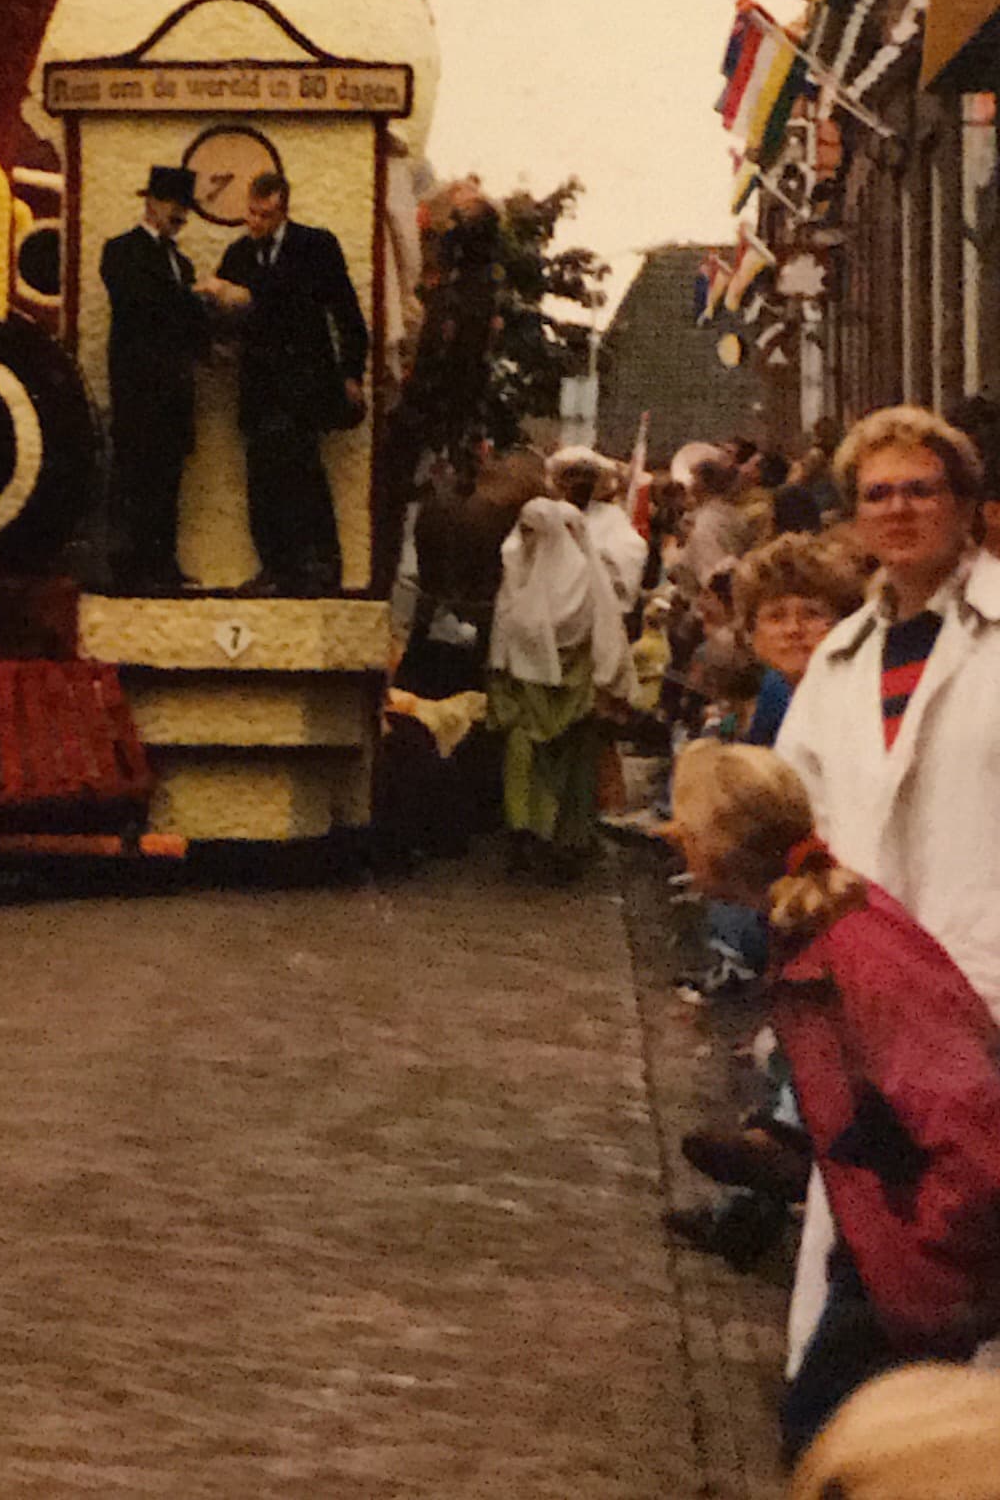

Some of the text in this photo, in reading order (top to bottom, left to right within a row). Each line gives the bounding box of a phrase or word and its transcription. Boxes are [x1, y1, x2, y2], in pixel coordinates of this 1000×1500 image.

[300, 75, 328, 100] 80
[206, 173, 235, 202] 7
[231, 626, 241, 649] 7
